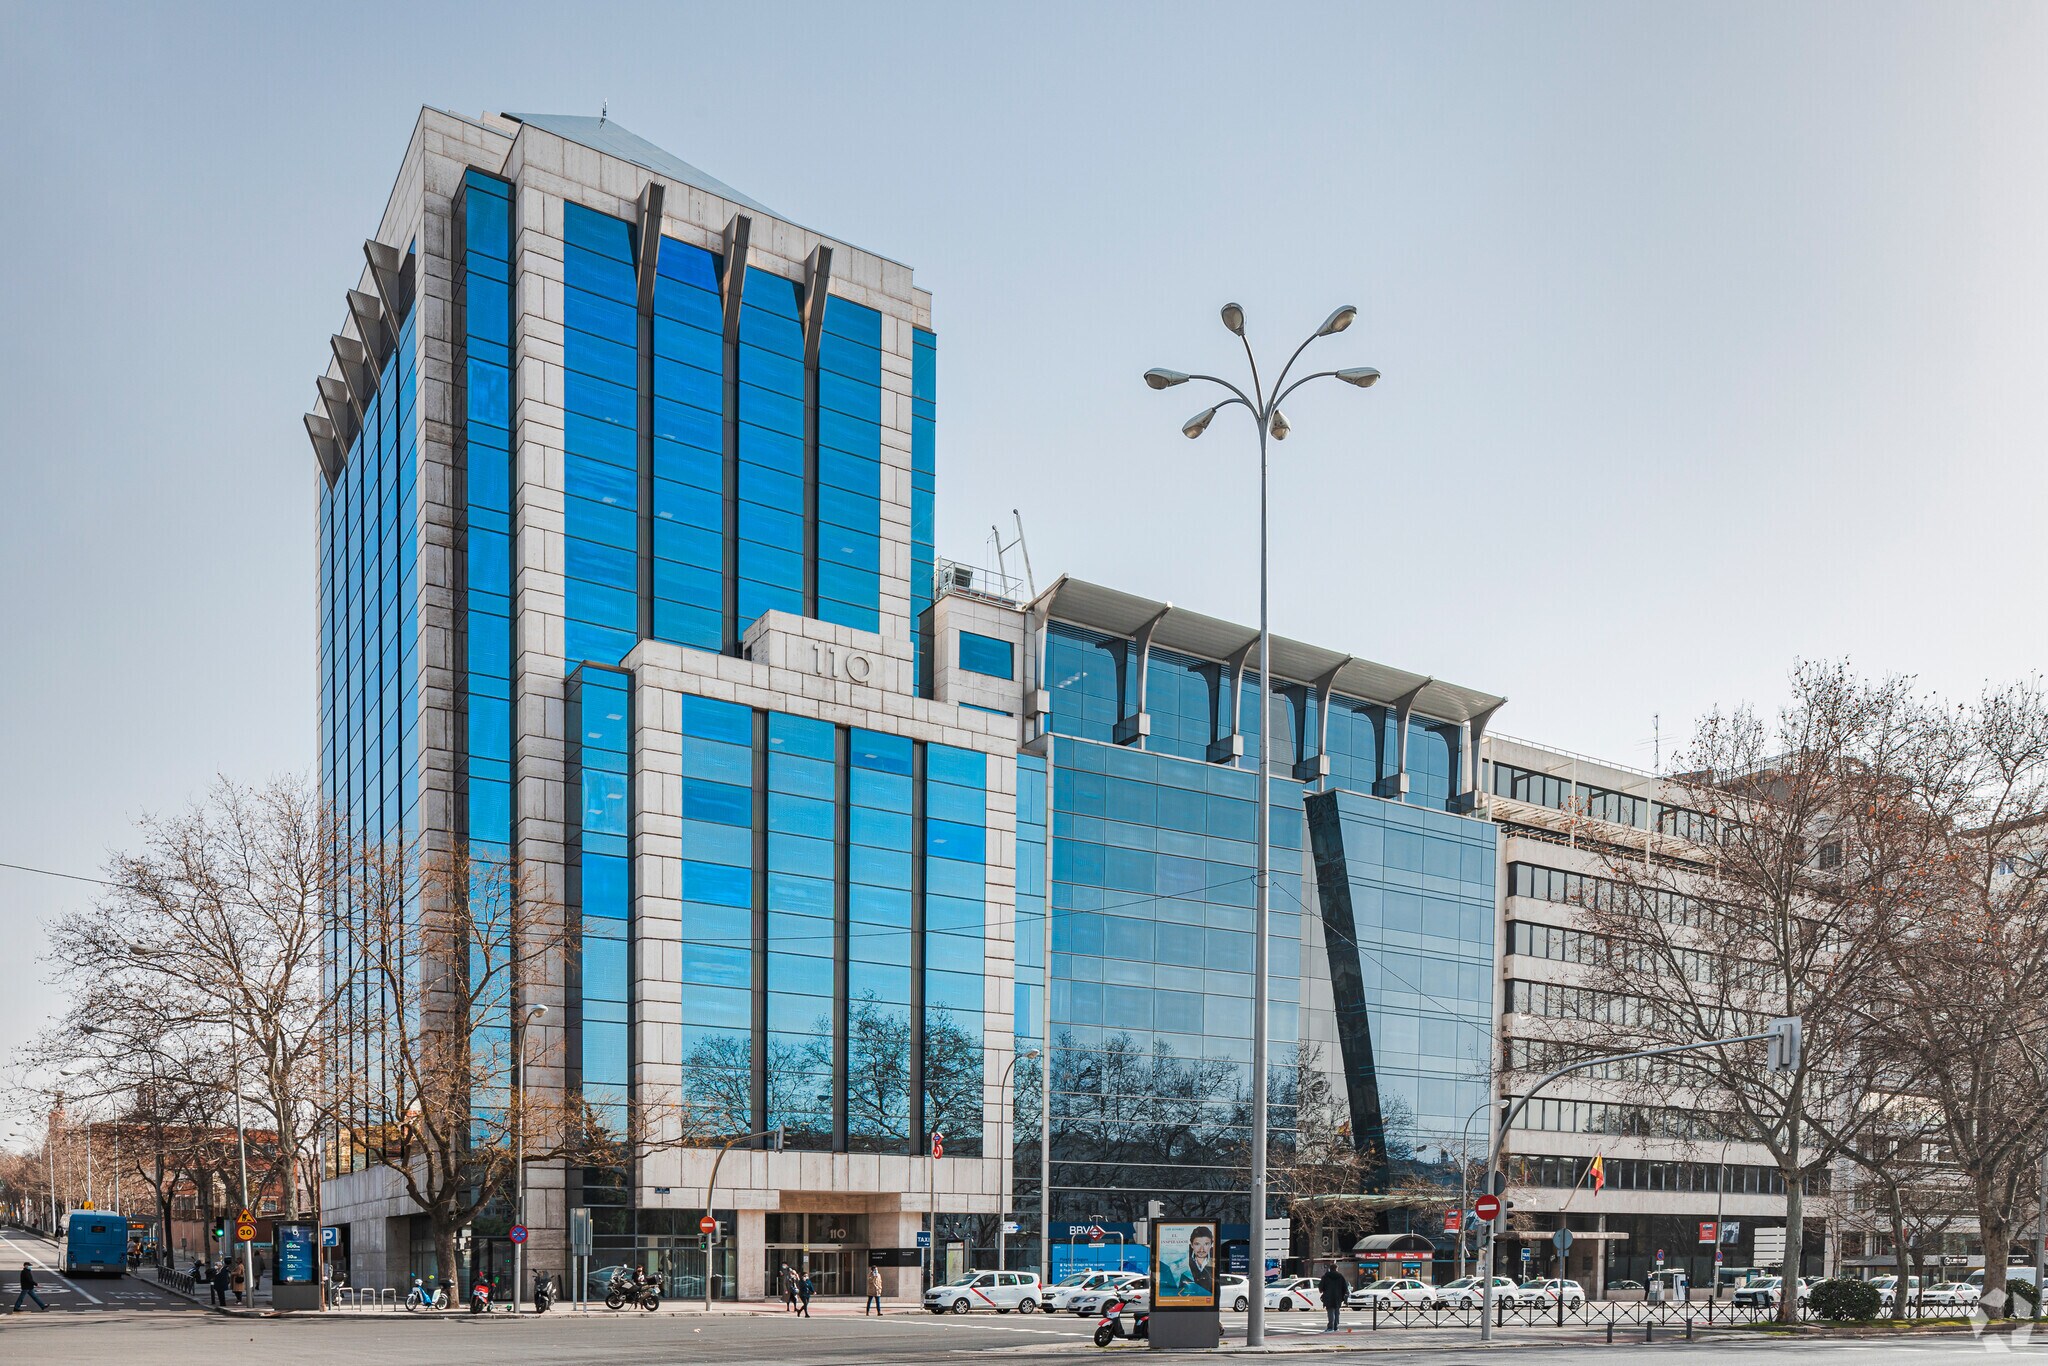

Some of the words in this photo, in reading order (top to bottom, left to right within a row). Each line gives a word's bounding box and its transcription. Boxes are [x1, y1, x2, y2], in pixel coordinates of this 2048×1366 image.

[813, 641, 873, 683] 110
[322, 1230, 333, 1244] P
[830, 1229, 846, 1239] 110
